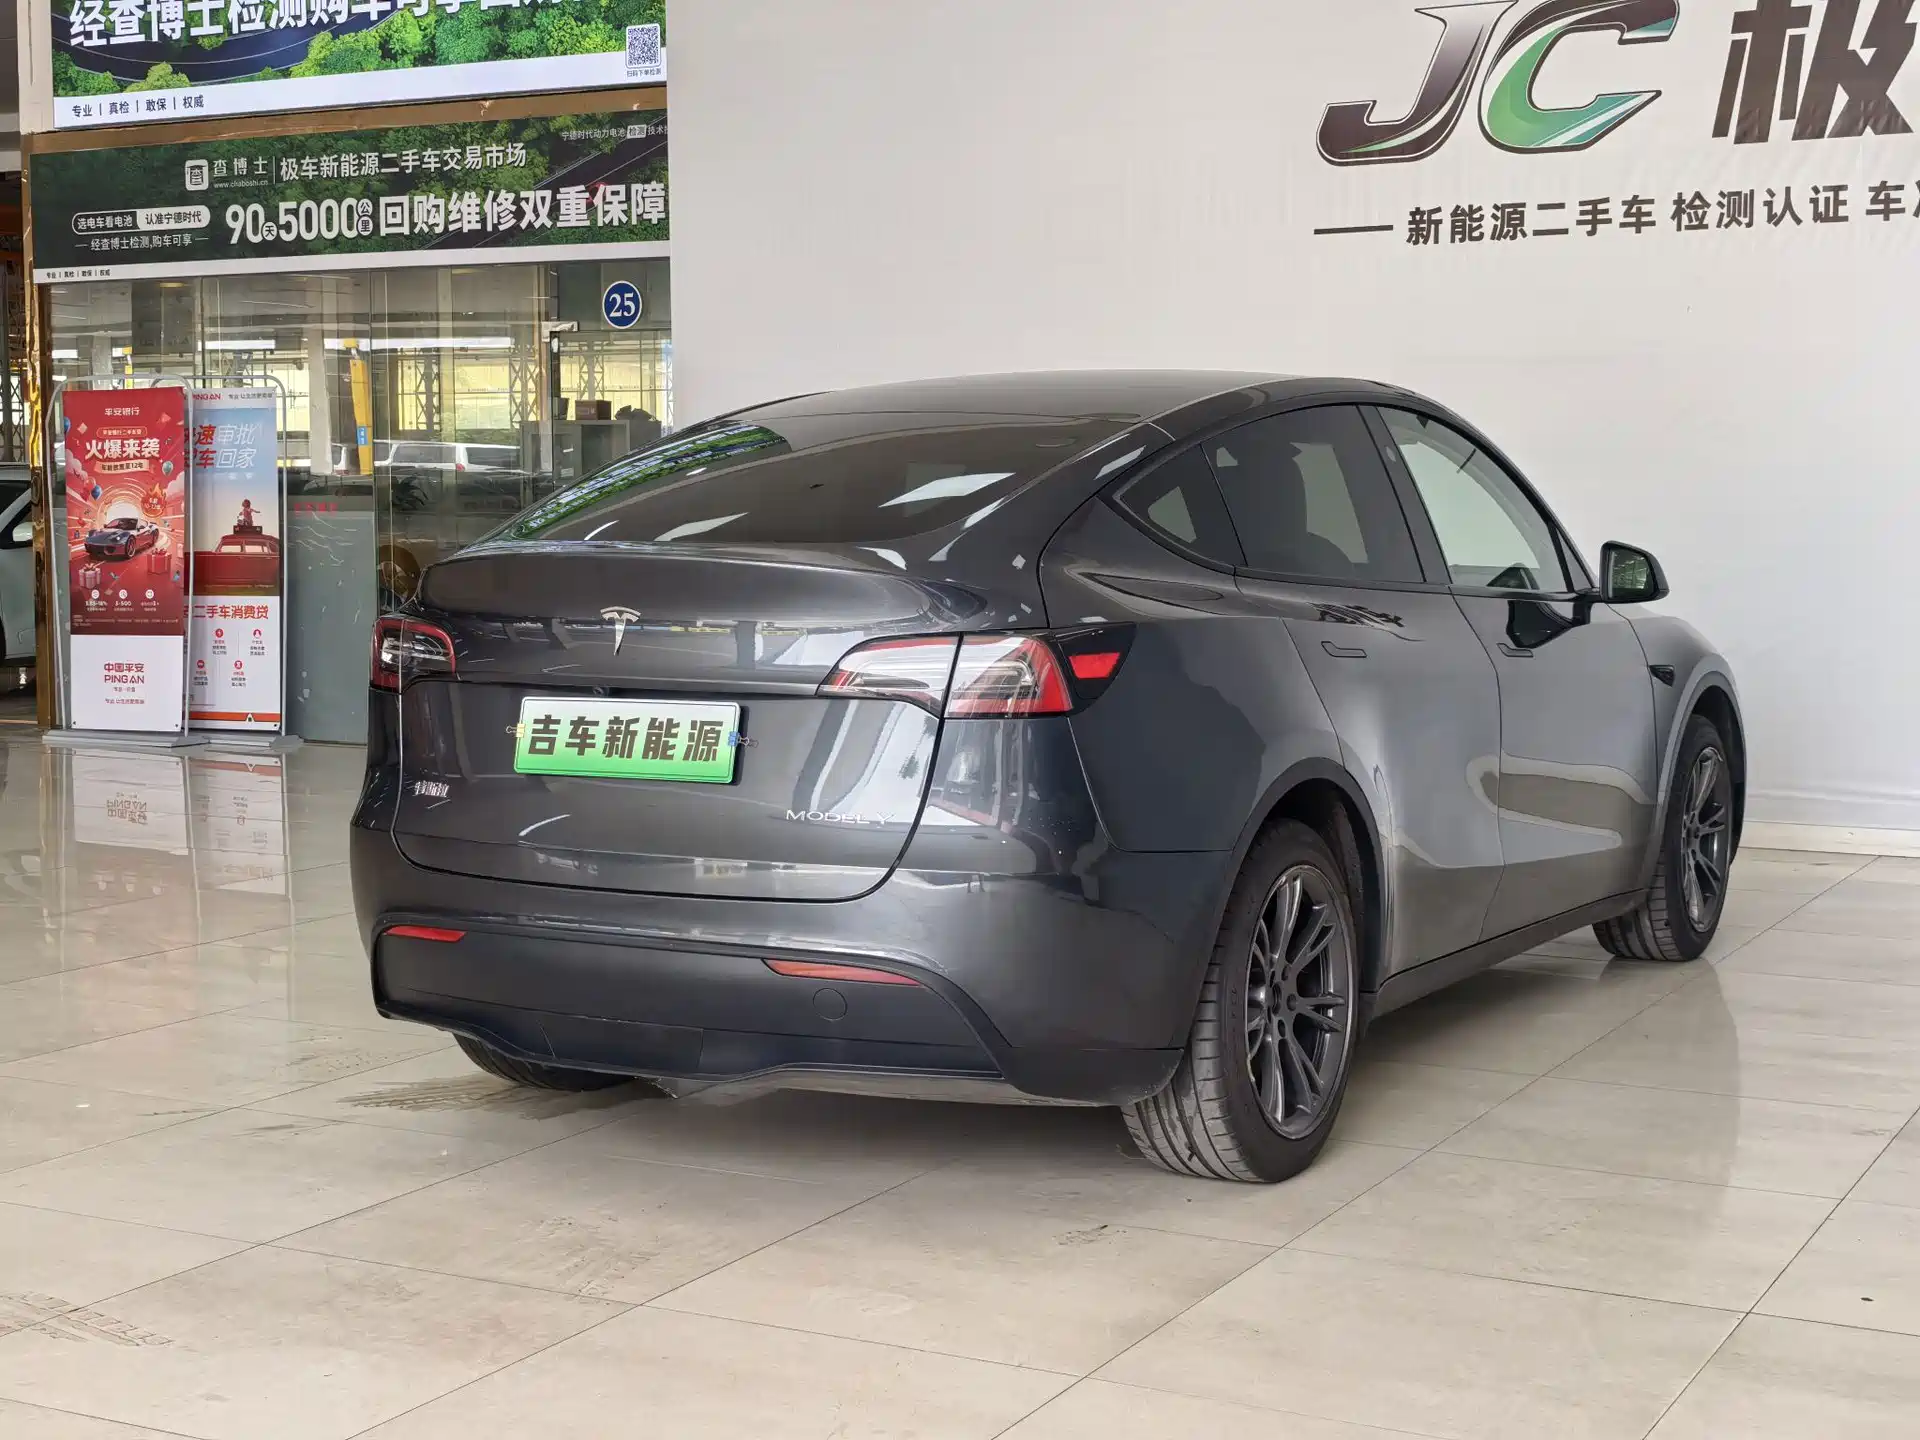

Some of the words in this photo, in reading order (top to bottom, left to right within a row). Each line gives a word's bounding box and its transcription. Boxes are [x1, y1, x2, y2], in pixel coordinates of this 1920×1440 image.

[1316, 0, 1680, 166] JC
[1711, 0, 1918, 145] 极
[72, 104, 93, 118] 专业
[108, 101, 130, 115] 真检
[145, 98, 167, 112] 敢保
[182, 95, 204, 109] 权威
[213, 156, 268, 178] 查博士
[279, 142, 526, 182] 极车新能源二手车交易市场
[214, 179, 269, 189] www.chaboshi.cn
[77, 212, 133, 231] 选电车看电池
[145, 208, 202, 227] 认准宁德时代
[1406, 195, 1656, 247] 新能源二手车
[1670, 184, 1850, 233] 检测认证
[609, 292, 636, 317] 25
[104, 406, 140, 416] 平安银行
[85, 437, 160, 460] 火爆来袭
[104, 663, 145, 673] 中国平安
[528, 714, 724, 762] 吉车新能源
[786, 809, 870, 824] MODEL
[876, 811, 896, 825] Y
